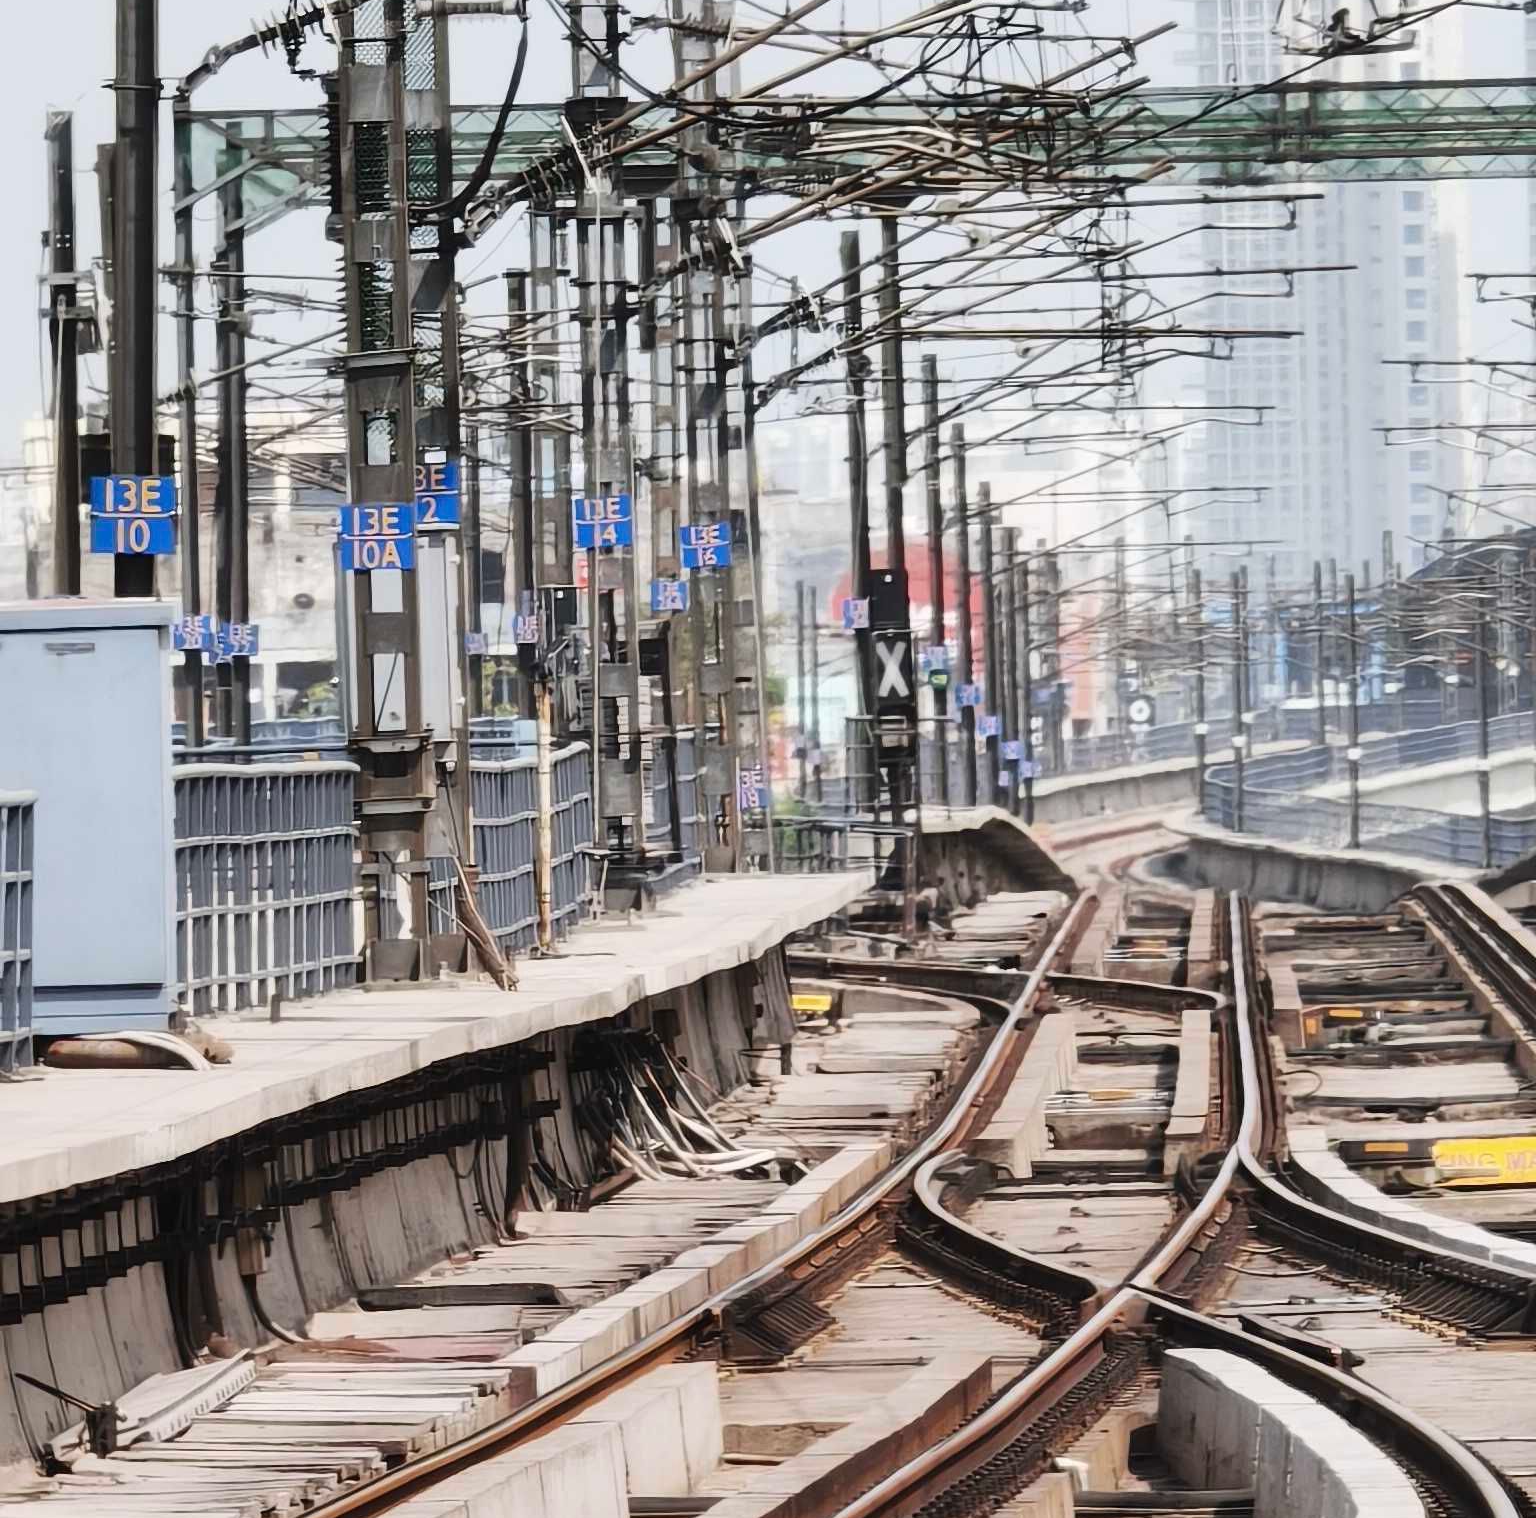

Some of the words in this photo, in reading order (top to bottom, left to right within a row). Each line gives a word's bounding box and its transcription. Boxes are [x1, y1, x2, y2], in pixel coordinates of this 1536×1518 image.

[414, 464, 448, 491] 3E
[105, 478, 162, 514] 13E
[421, 496, 441, 523] 2
[117, 518, 151, 554] 10
[353, 507, 400, 536] 13E
[353, 539, 400, 570] 10A
